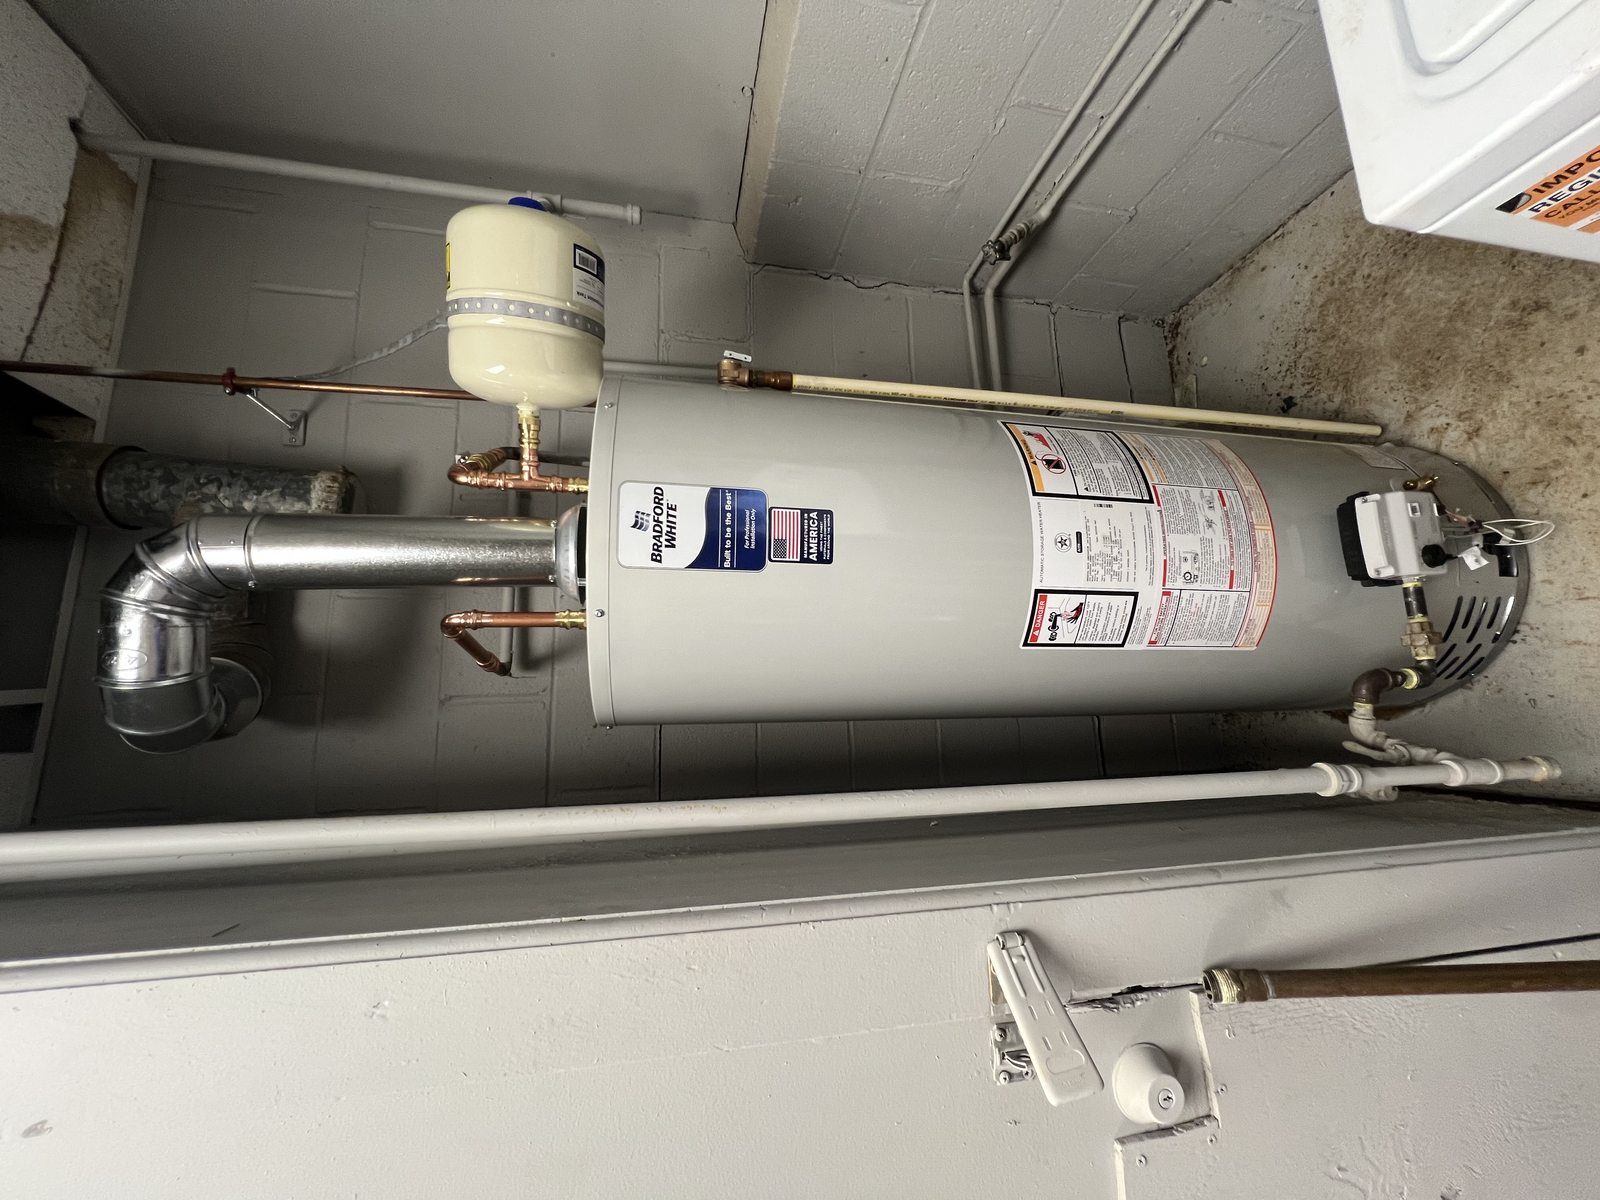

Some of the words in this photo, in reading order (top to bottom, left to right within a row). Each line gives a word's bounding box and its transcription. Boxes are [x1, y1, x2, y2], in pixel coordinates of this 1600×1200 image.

[1528, 168, 1600, 213] REGI
[651, 486, 664, 564] BRADFORD
[664, 502, 677, 549] WHITE
[725, 527, 731, 538] be
[725, 540, 731, 549] to
[809, 511, 818, 561] AMERICA
[1034, 600, 1046, 628] DANGER
